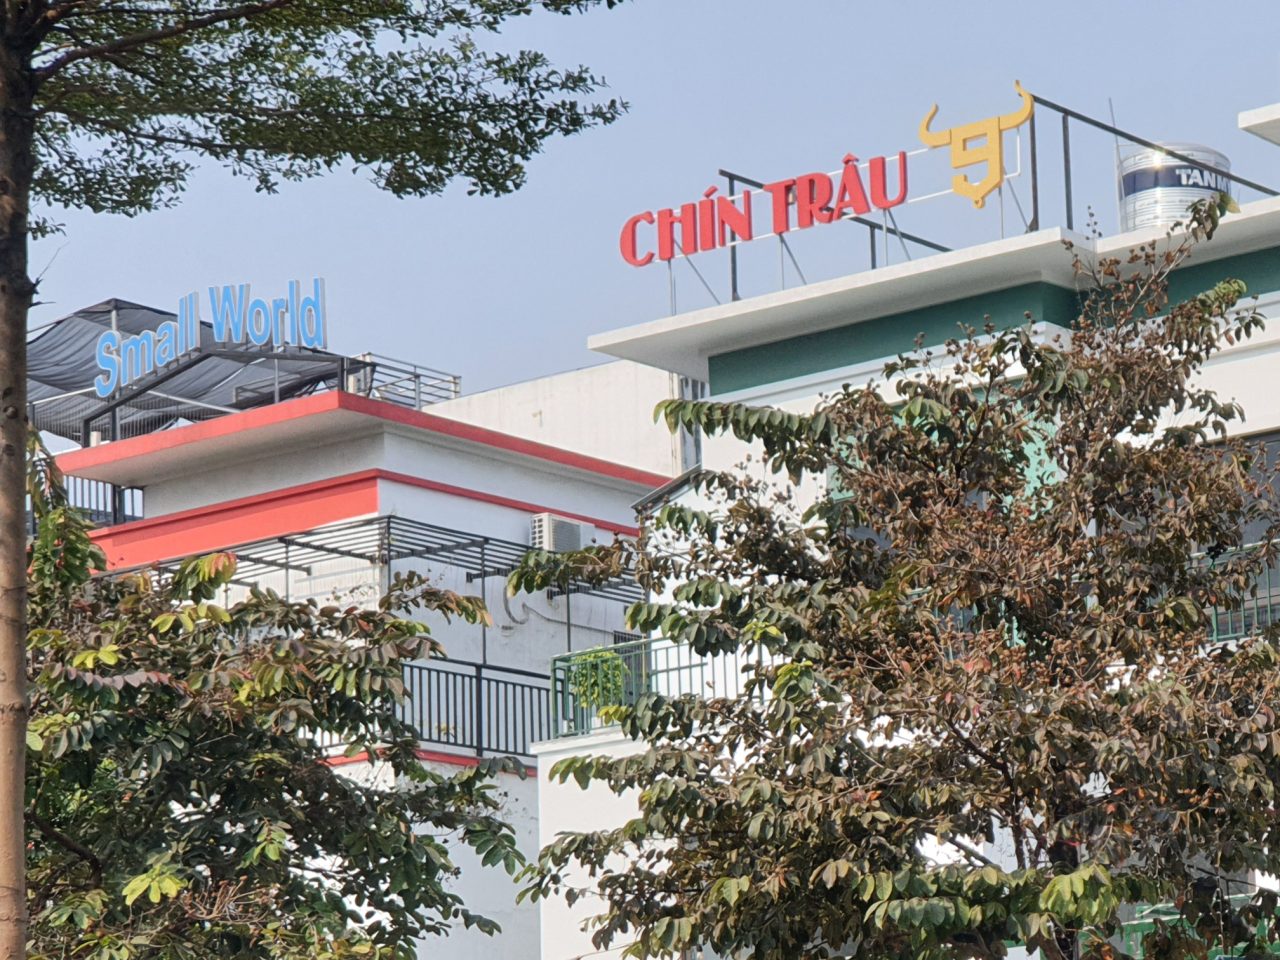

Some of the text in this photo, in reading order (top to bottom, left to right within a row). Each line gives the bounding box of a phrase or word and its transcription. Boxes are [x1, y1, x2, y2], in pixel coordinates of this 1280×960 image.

[619, 151, 907, 267] CHÍN TRÂU
[95, 277, 327, 398] Small World
